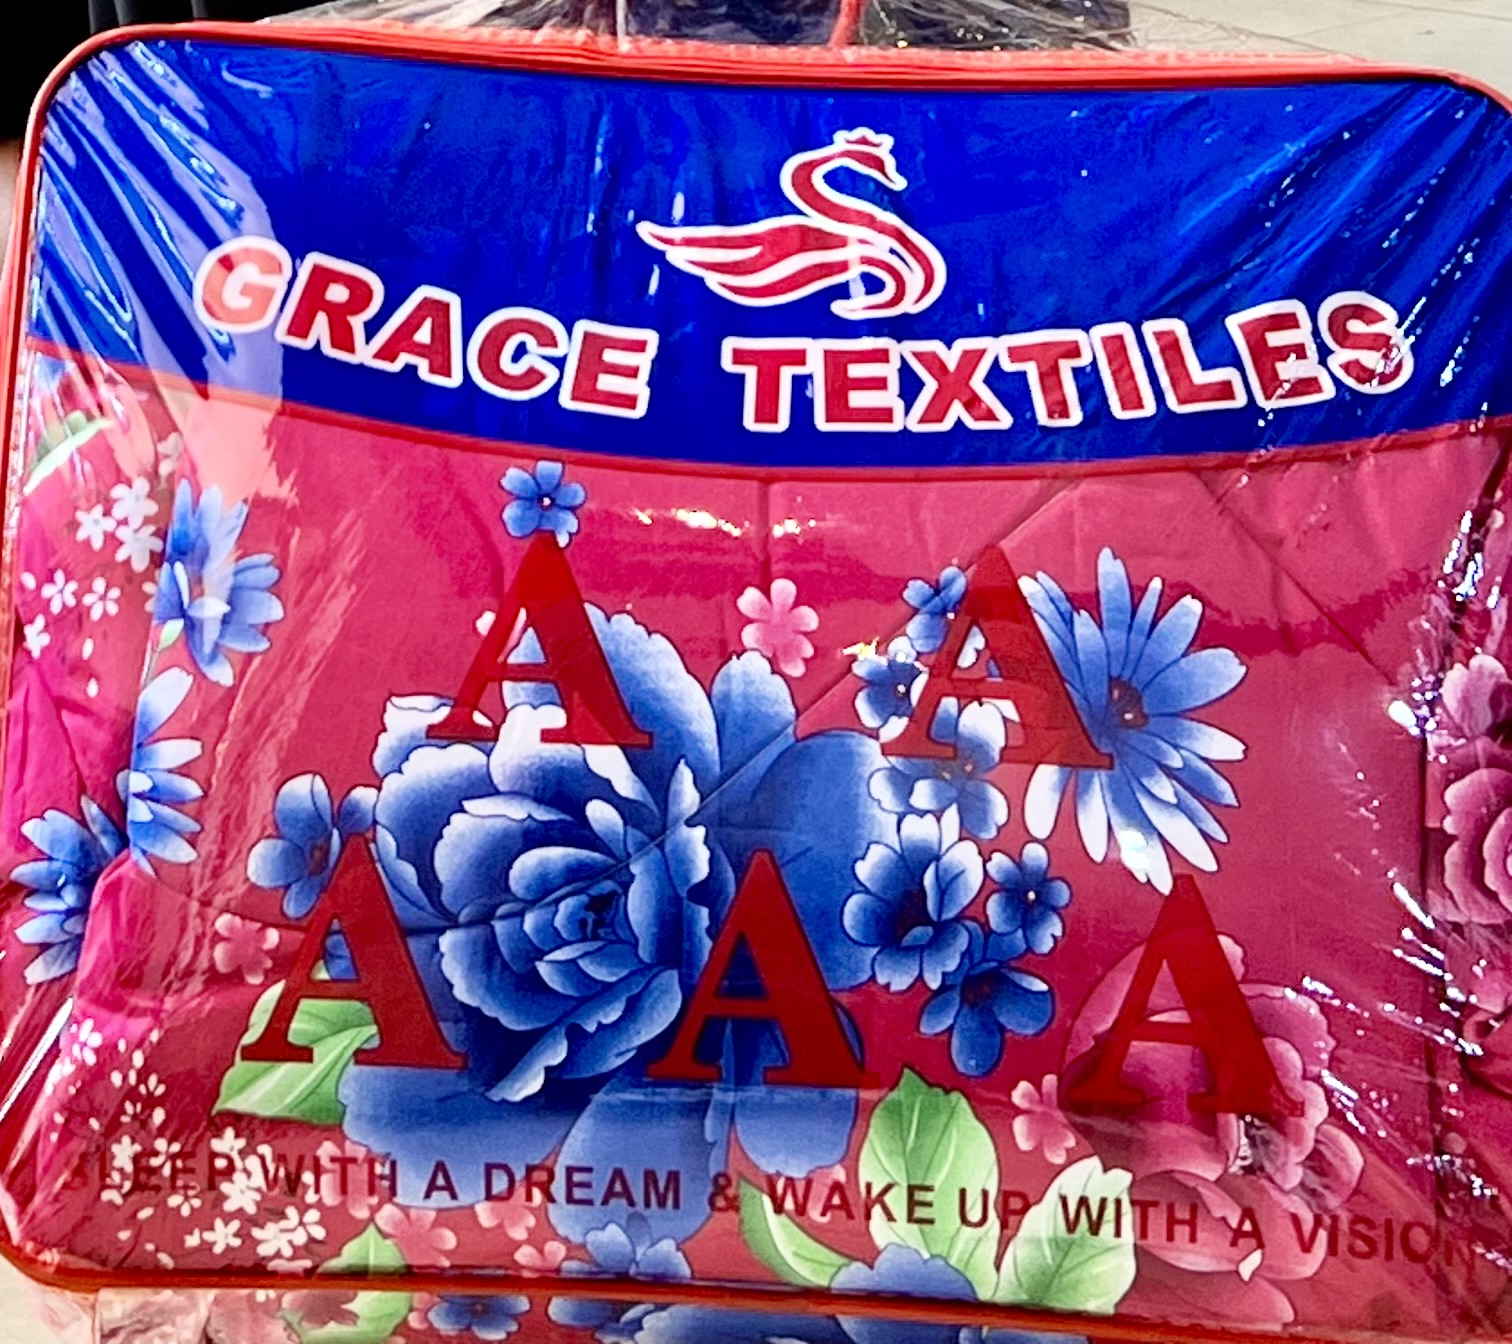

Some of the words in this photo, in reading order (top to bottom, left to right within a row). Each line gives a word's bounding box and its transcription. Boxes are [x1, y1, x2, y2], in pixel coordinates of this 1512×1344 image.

[193, 234, 659, 419] GRACE
[720, 290, 1414, 433] TEXTILES
[427, 529, 653, 748] A
[886, 543, 1115, 770] A
[241, 833, 468, 1069] A
[648, 849, 880, 1089] A
[1060, 873, 1304, 1117] A
[262, 1151, 398, 1199] WITH
[423, 1158, 460, 1202] A
[479, 1159, 682, 1212] DREAM
[708, 1171, 739, 1213] &
[766, 1174, 936, 1227] WAKE
[956, 1188, 1032, 1231] UP
[1059, 1193, 1200, 1244] WITH
[1229, 1204, 1266, 1250] A
